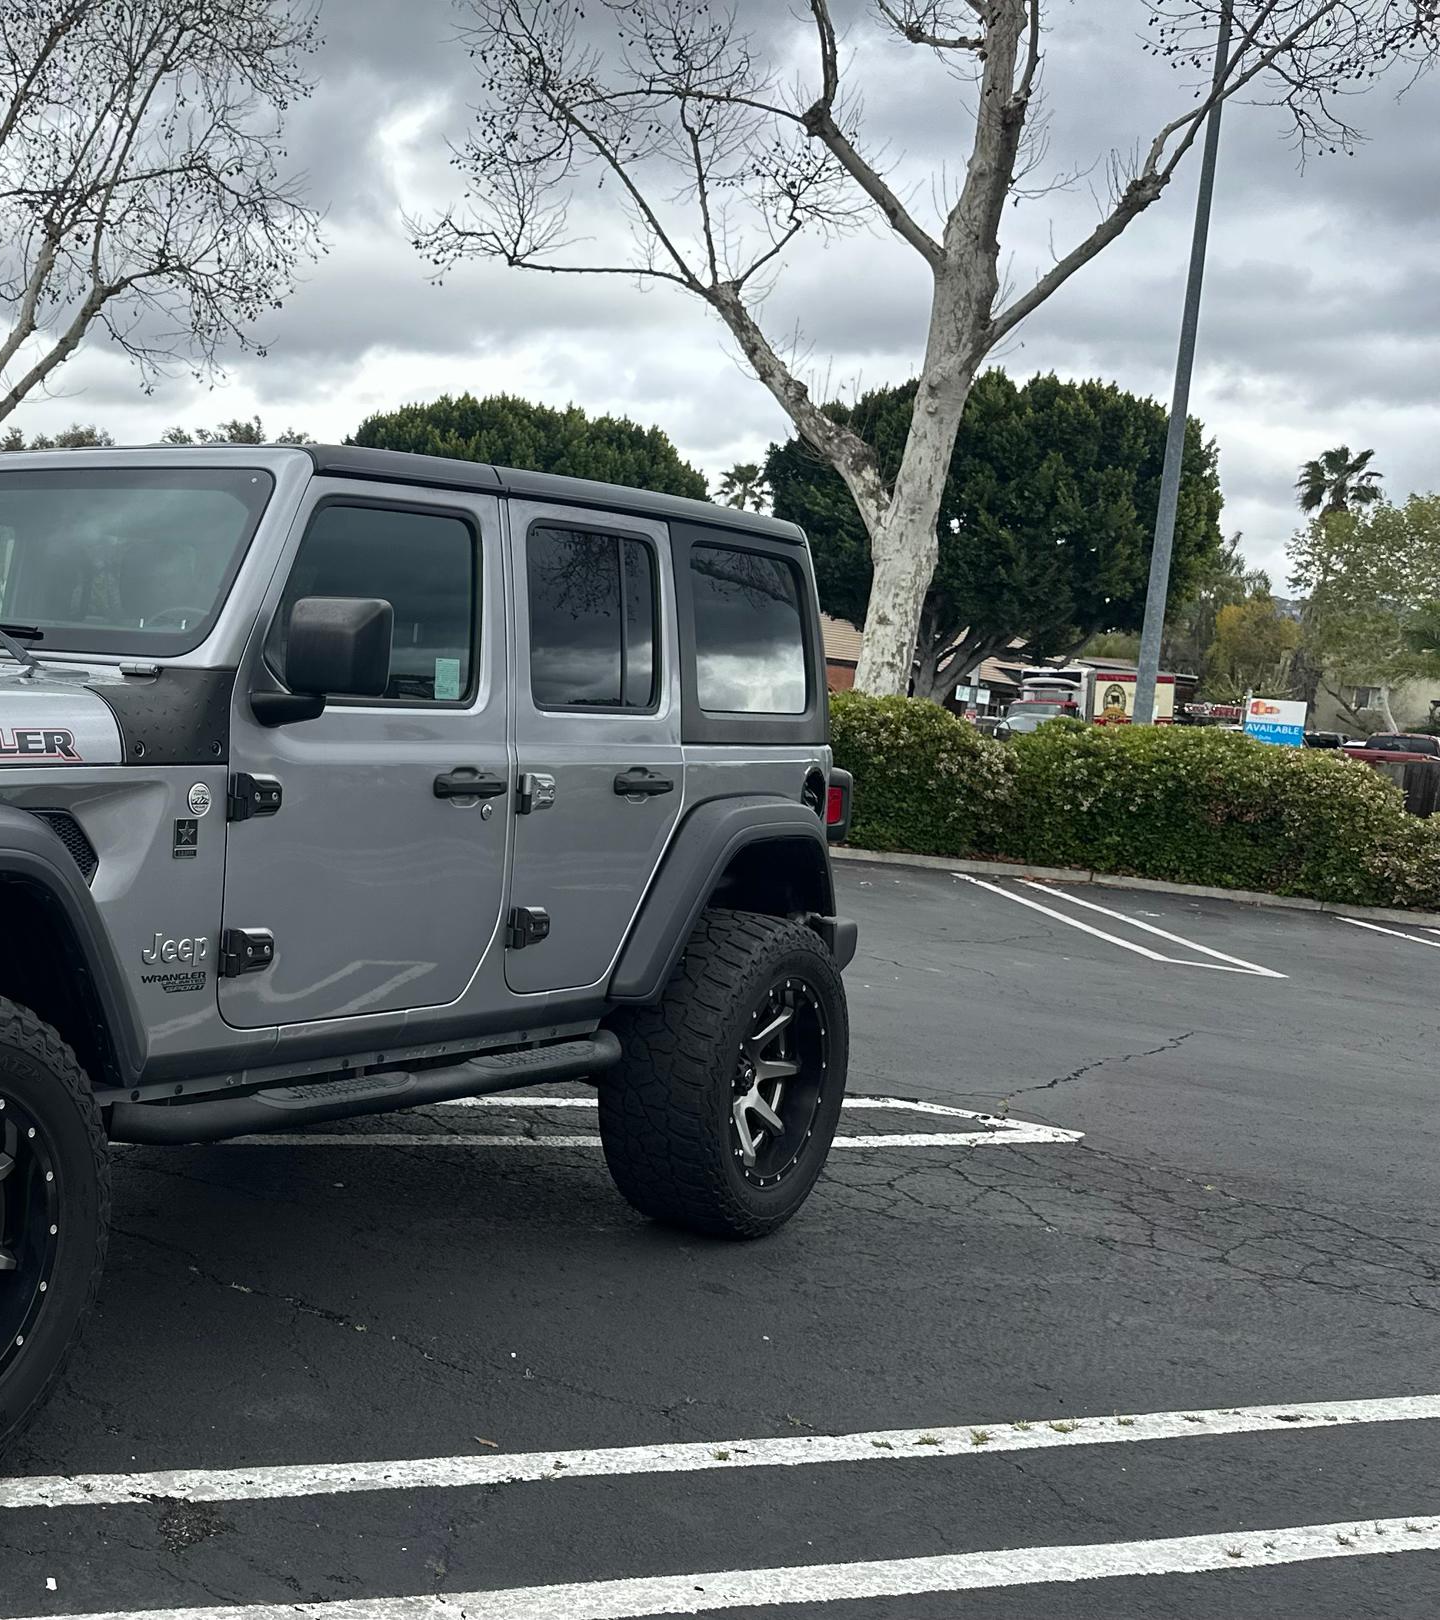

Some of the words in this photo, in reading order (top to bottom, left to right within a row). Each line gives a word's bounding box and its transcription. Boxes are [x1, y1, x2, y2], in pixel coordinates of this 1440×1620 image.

[1246, 723, 1300, 735] AVAILABLE
[142, 933, 208, 967] Jeep
[141, 971, 206, 984] WRANGLER
